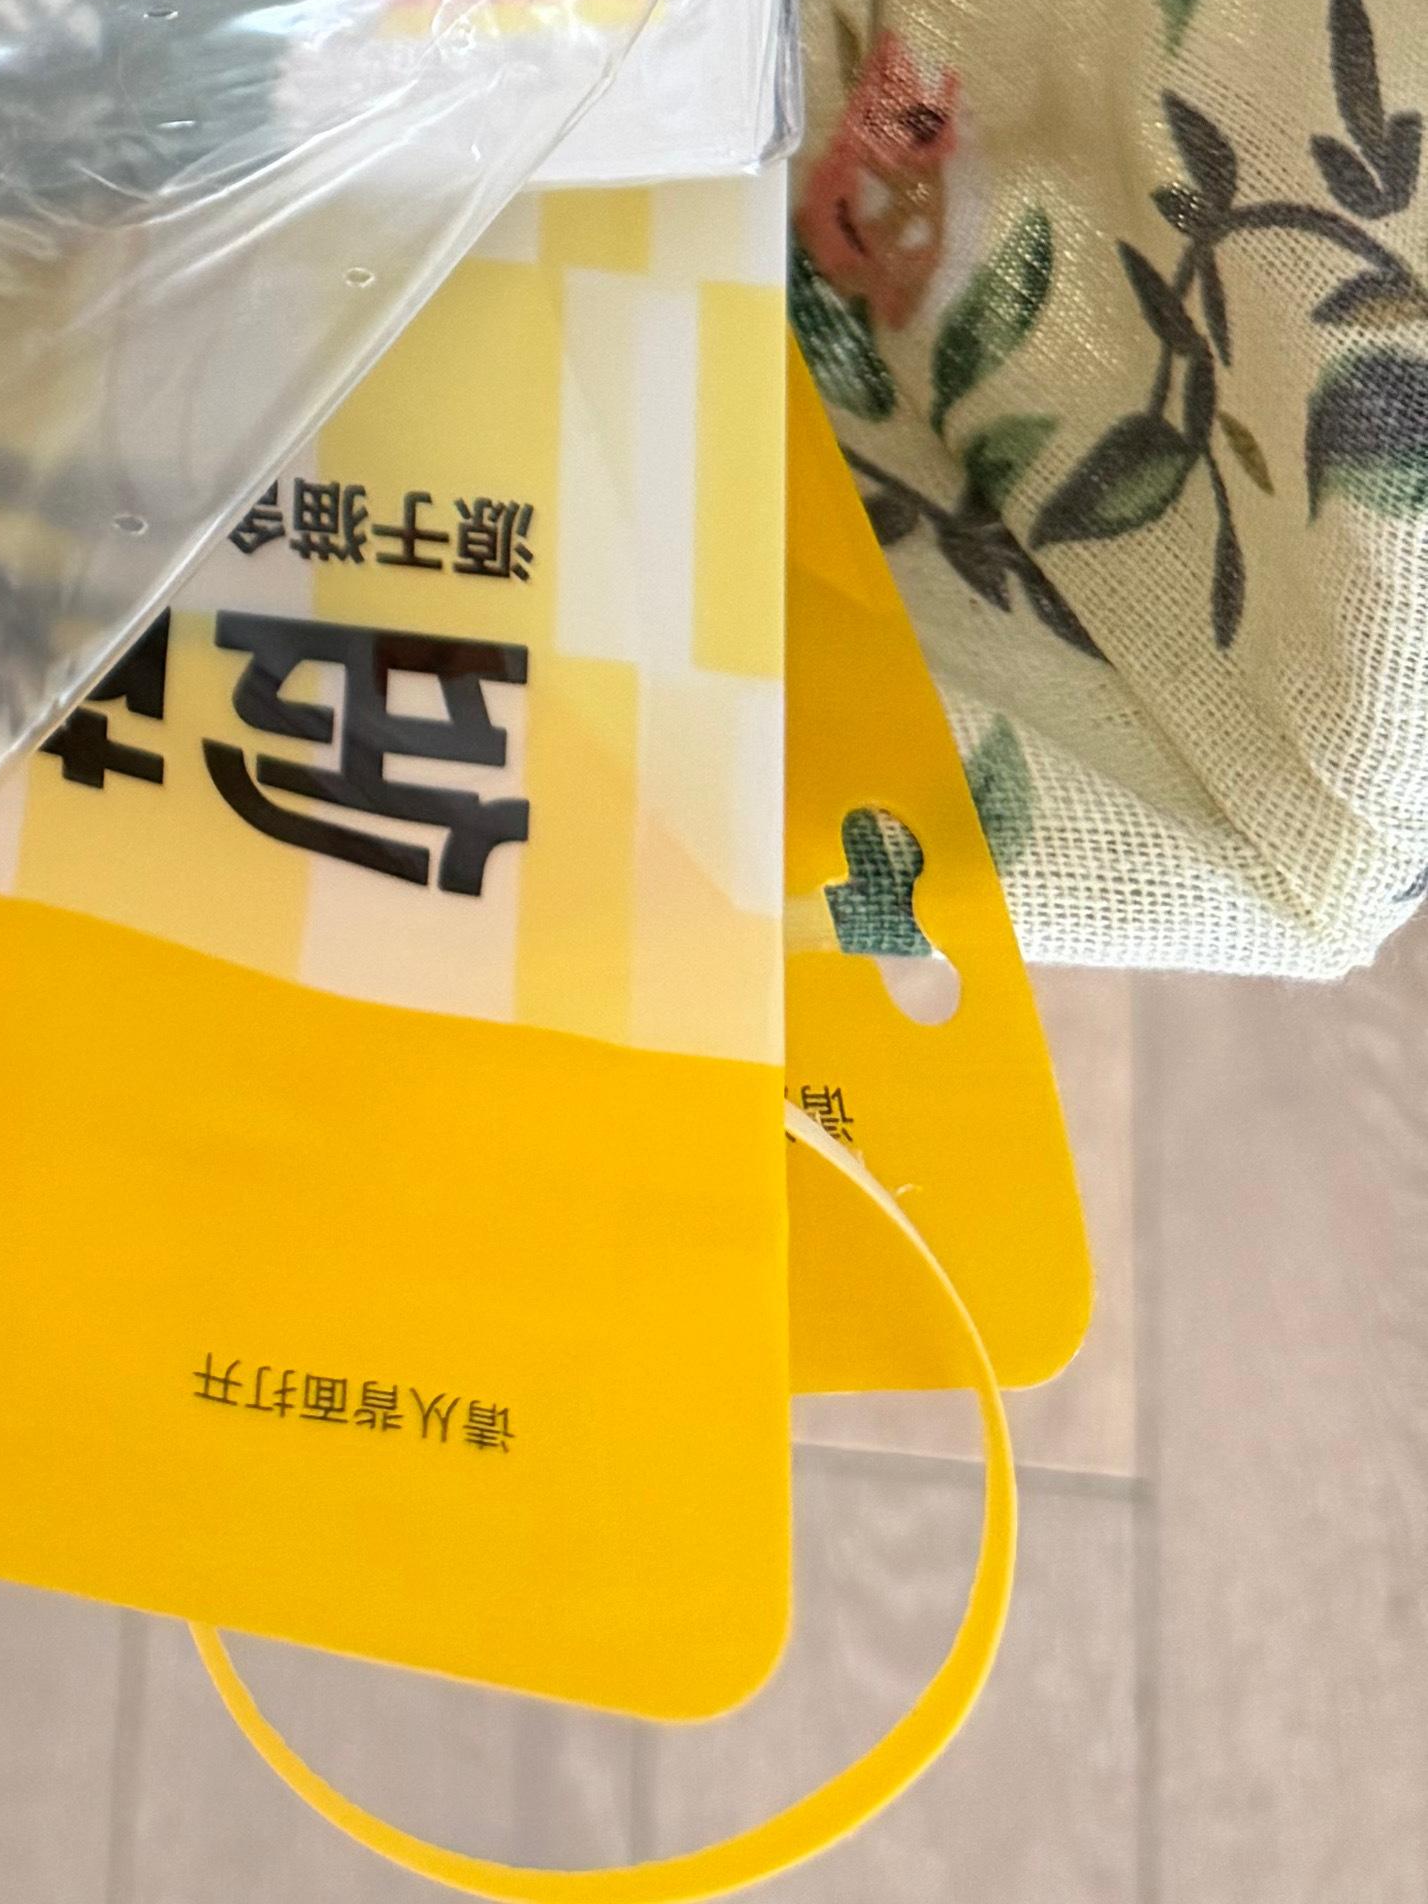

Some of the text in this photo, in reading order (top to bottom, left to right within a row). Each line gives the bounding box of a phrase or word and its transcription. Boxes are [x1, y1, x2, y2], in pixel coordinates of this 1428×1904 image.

[192, 1351, 517, 1454] 请从背面打开
